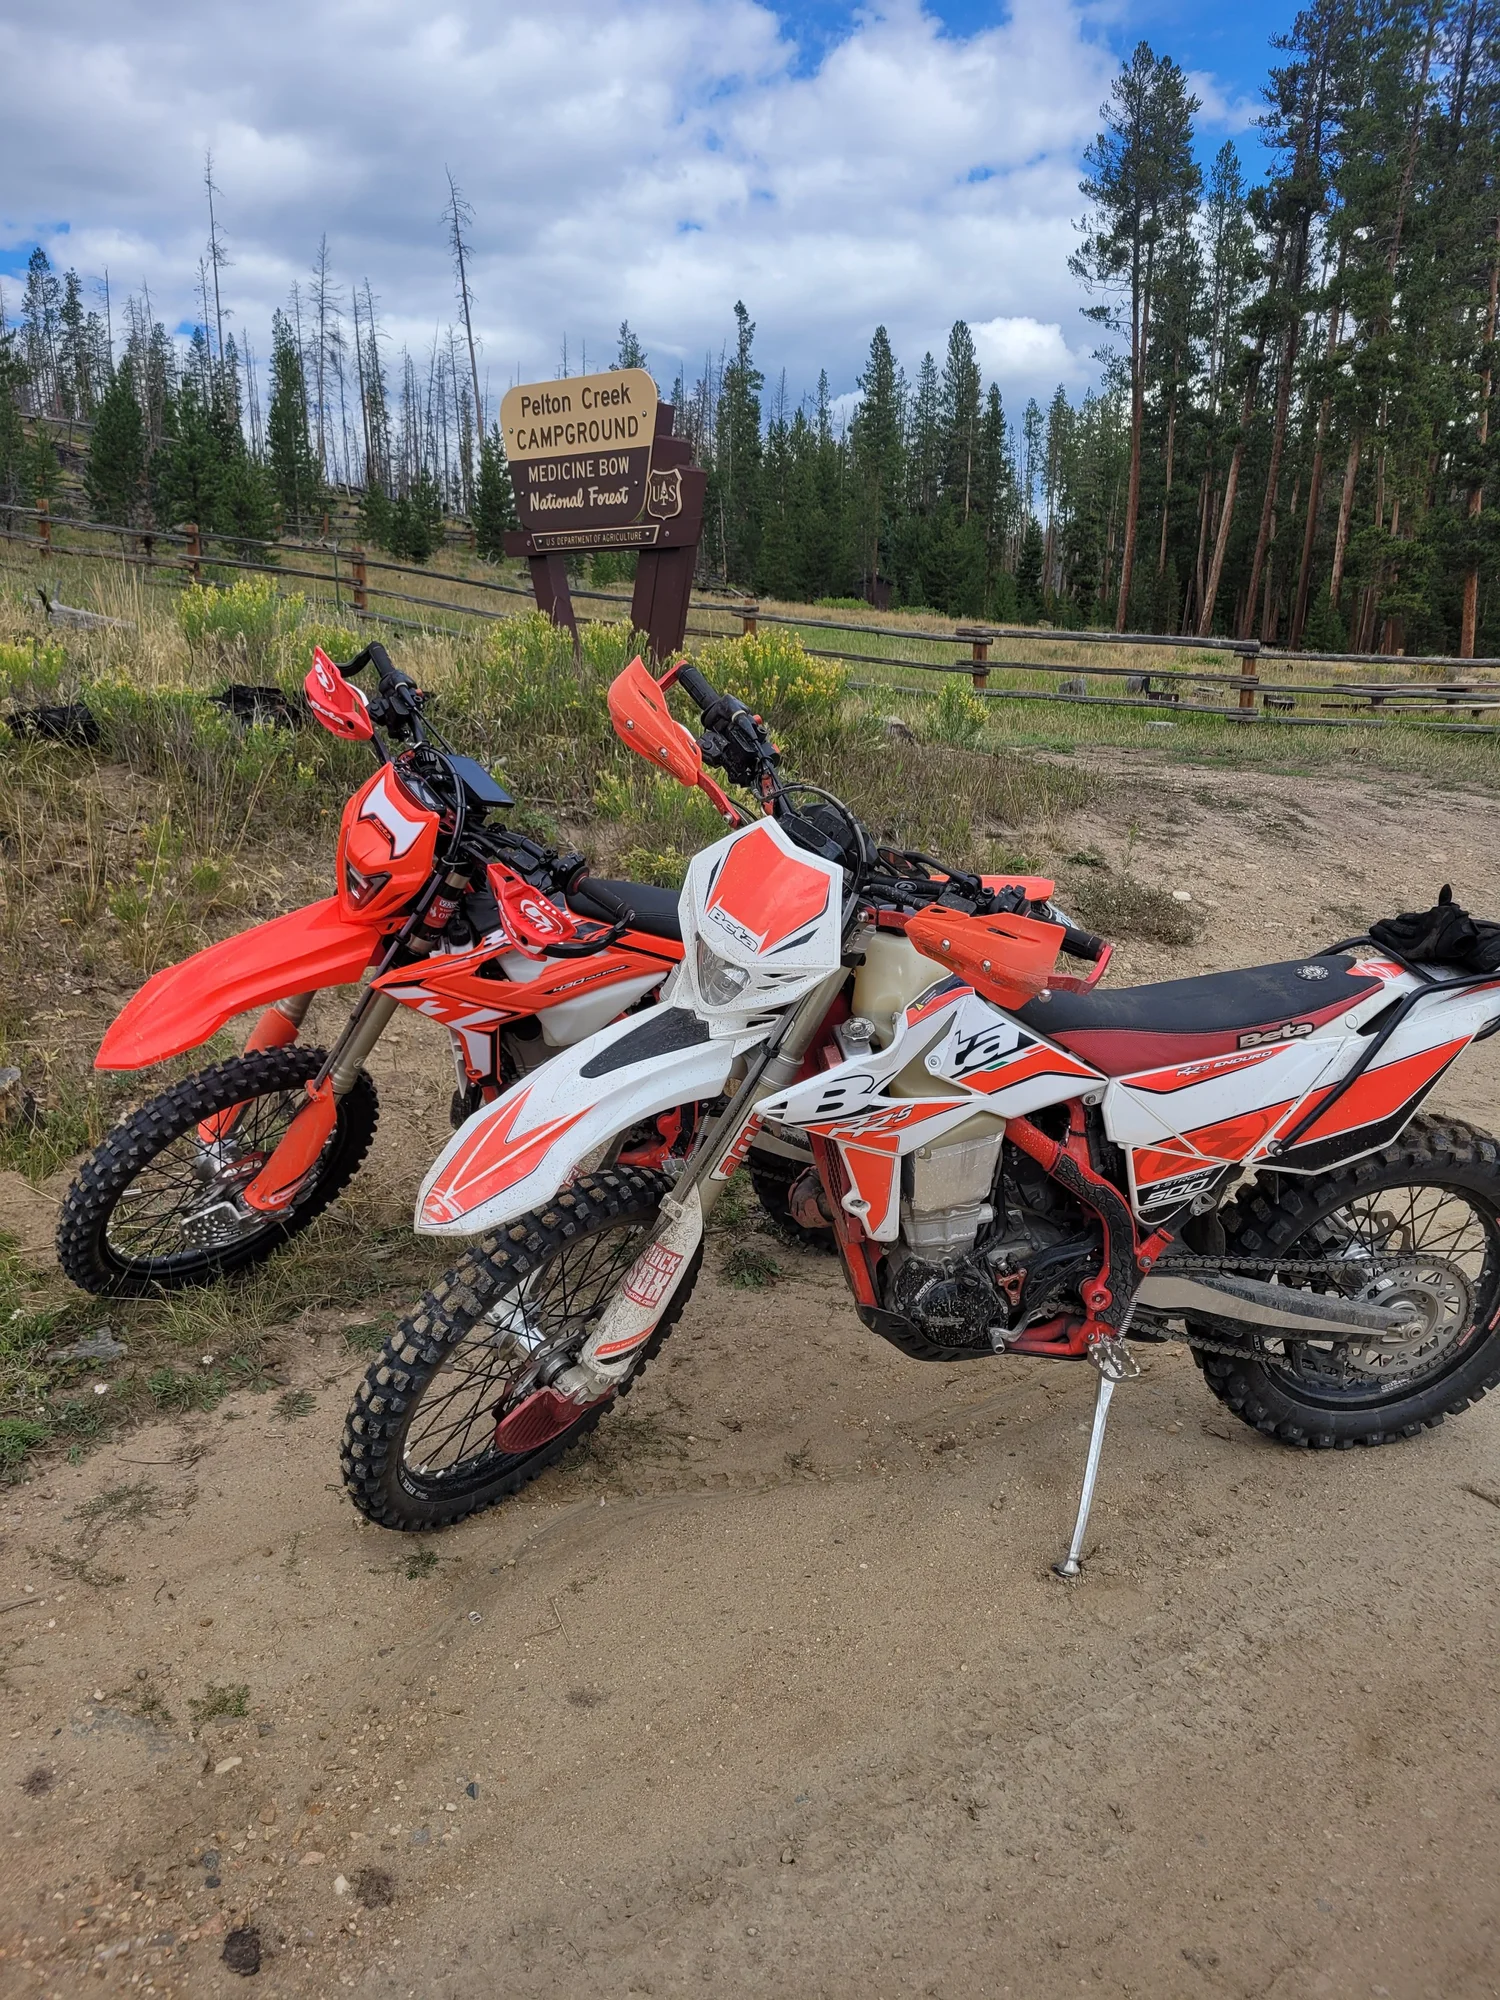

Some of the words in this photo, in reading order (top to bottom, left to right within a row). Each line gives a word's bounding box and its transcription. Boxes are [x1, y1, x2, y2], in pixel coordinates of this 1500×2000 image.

[520, 393, 572, 418] Pelton
[581, 382, 632, 410] Creek
[516, 415, 639, 450] CAMPGROUND
[528, 460, 595, 483] MEDICINE
[599, 456, 630, 477] BOW
[530, 487, 584, 512] National
[588, 486, 629, 506] Forest
[556, 534, 593, 546] DEPARTMENT
[593, 534, 601, 543] OF
[602, 531, 642, 543] AGRICULTURE
[707, 906, 759, 953] Beta
[1238, 1022, 1315, 1050] Beta
[1212, 1050, 1274, 1069] ENDURO
[1143, 1178, 1210, 1205] 500
[914, 1277, 938, 1302] MOTUL
